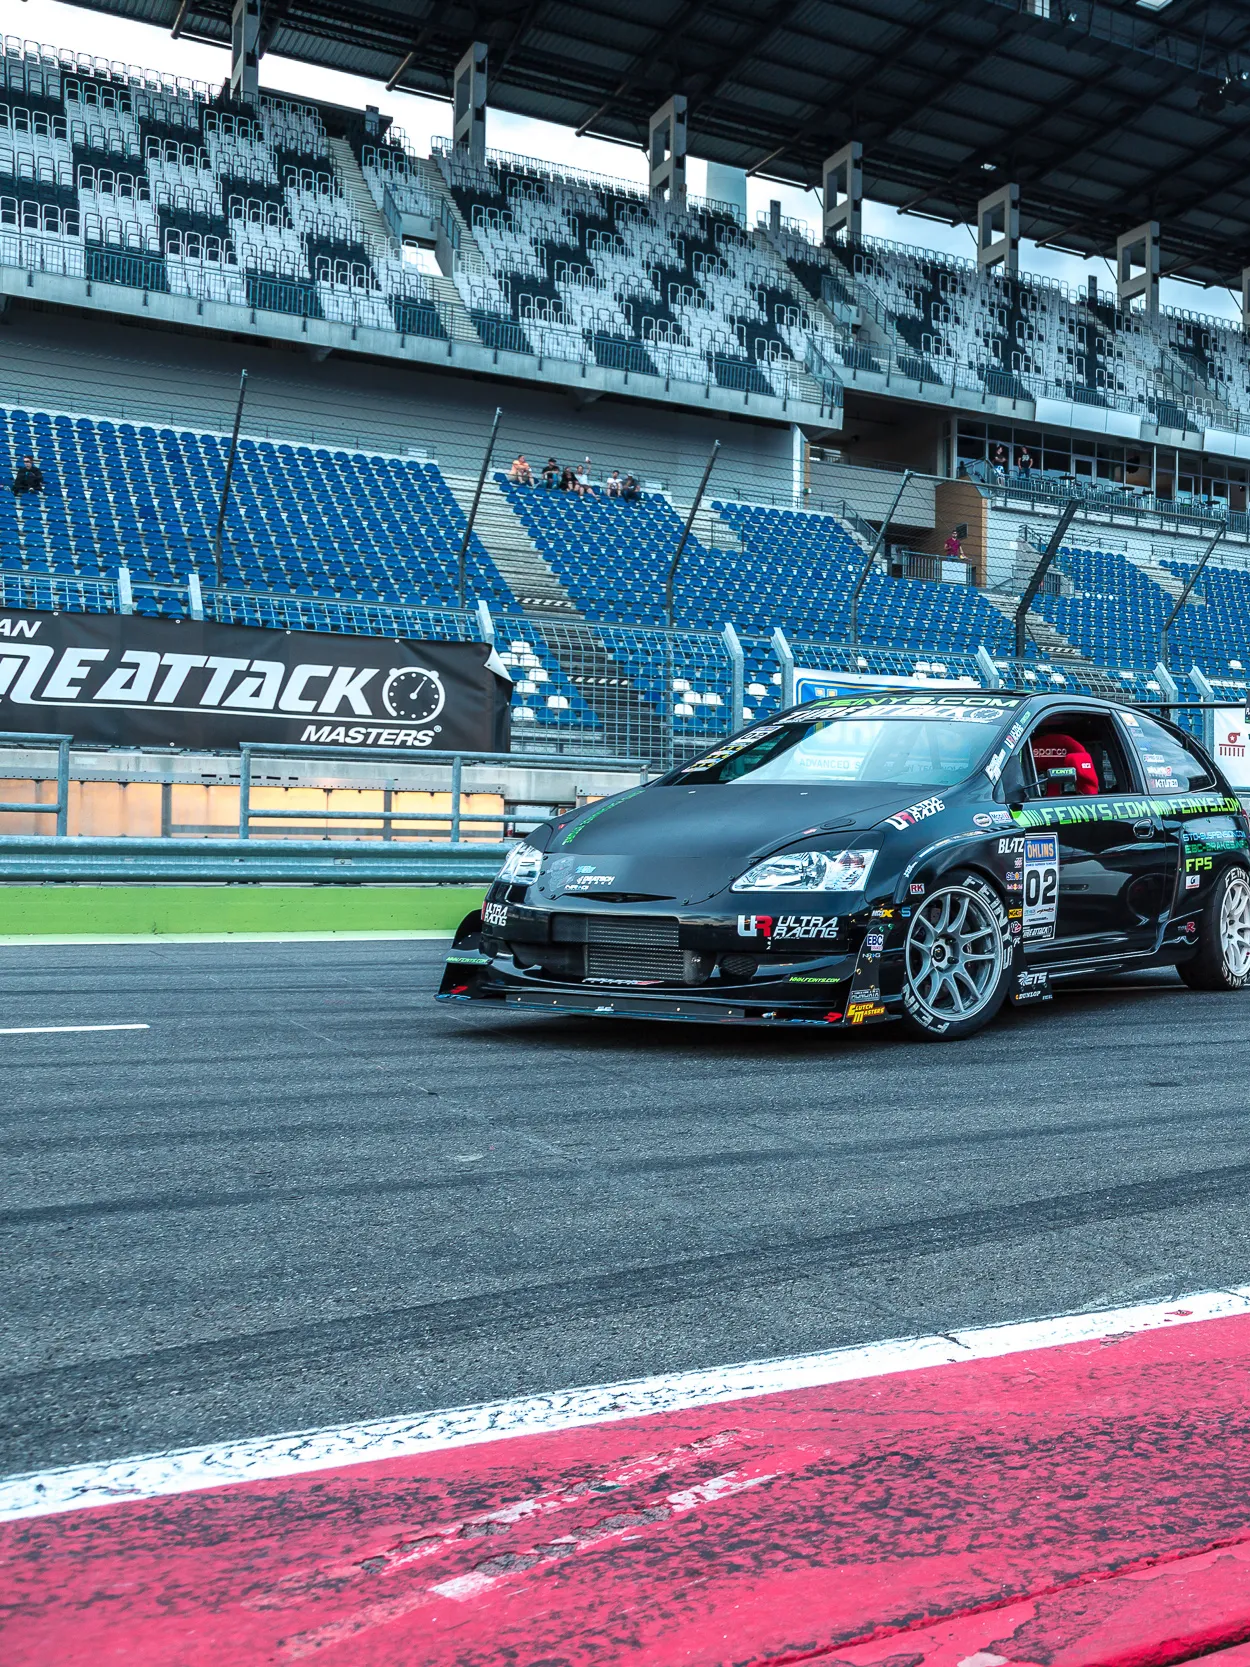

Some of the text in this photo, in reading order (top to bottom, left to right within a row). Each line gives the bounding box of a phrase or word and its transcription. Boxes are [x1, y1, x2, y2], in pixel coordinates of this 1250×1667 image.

[93, 650, 380, 717] ATTACK
[808, 697, 1019, 709] FEINYS.COM
[300, 725, 436, 748] MASTERS
[1033, 748, 1067, 757] sparco
[1170, 797, 1242, 815] FEINYS.COM
[1042, 801, 1150, 827] FEINYS.COM
[1027, 841, 1055, 859] ÖHLINS
[1186, 857, 1212, 872] FPS
[911, 884, 924, 893] RK
[1026, 868, 1057, 907] 02
[777, 915, 839, 928] ULTRA
[773, 926, 840, 938] RACING
[867, 935, 883, 946] EBC
